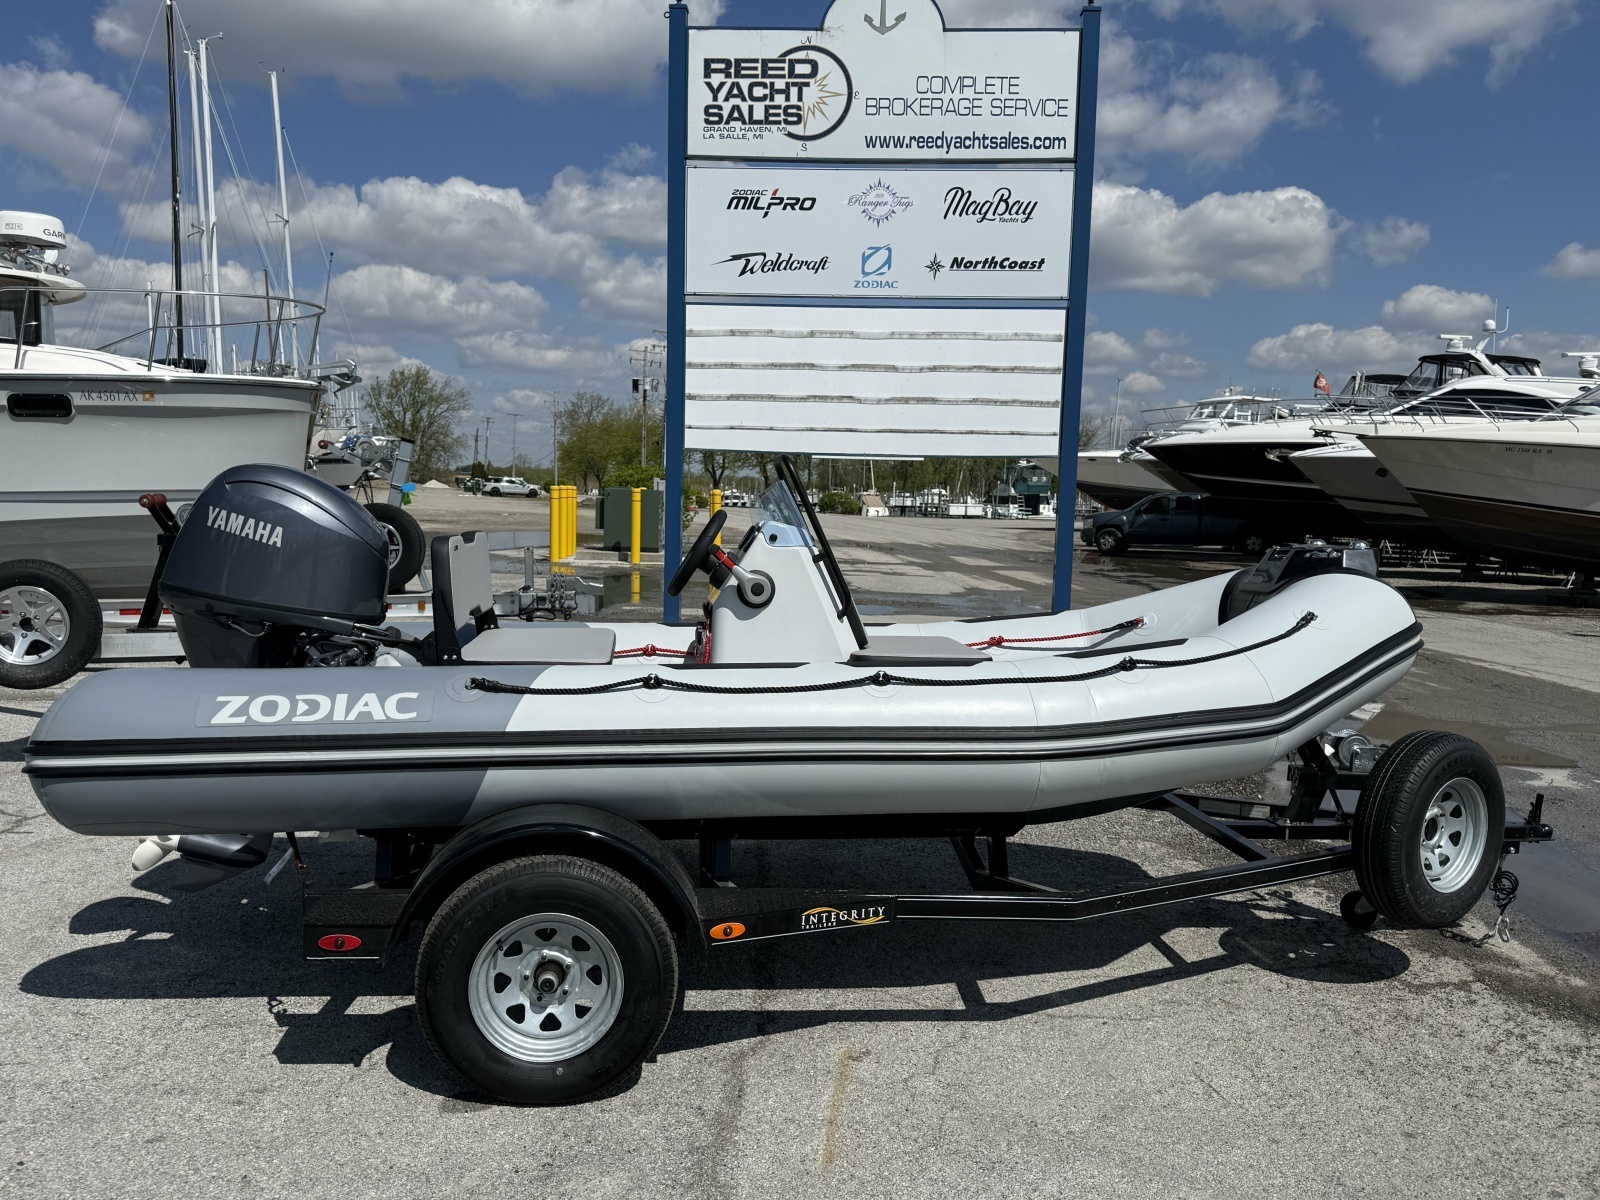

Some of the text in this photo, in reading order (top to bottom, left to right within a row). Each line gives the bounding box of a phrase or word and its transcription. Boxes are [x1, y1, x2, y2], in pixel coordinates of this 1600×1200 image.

[703, 58, 819, 79] REED
[703, 81, 811, 102] YACHT
[916, 75, 1020, 95] COMPLETE
[703, 104, 803, 126] SALES
[865, 97, 1069, 117] BROKERAGE SERVICE
[718, 133, 750, 141] SALLE,
[739, 126, 774, 134] HAVEN,
[865, 131, 1067, 155] www.reedyachtsales.com
[726, 195, 817, 218] MILPRO
[847, 194, 889, 212] Ranger
[889, 195, 914, 213] Tugs
[943, 186, 1039, 224] MagBay
[998, 216, 1019, 224] Yachts
[709, 251, 831, 278] Weldcraft
[949, 256, 1046, 270] NorthCoast
[853, 280, 899, 289] ZODIAC
[80, 389, 138, 402] AK 4561 AX
[206, 505, 284, 548] YAMAHA
[210, 692, 420, 724] ZODIAC
[801, 906, 886, 926] INTEGRITY
